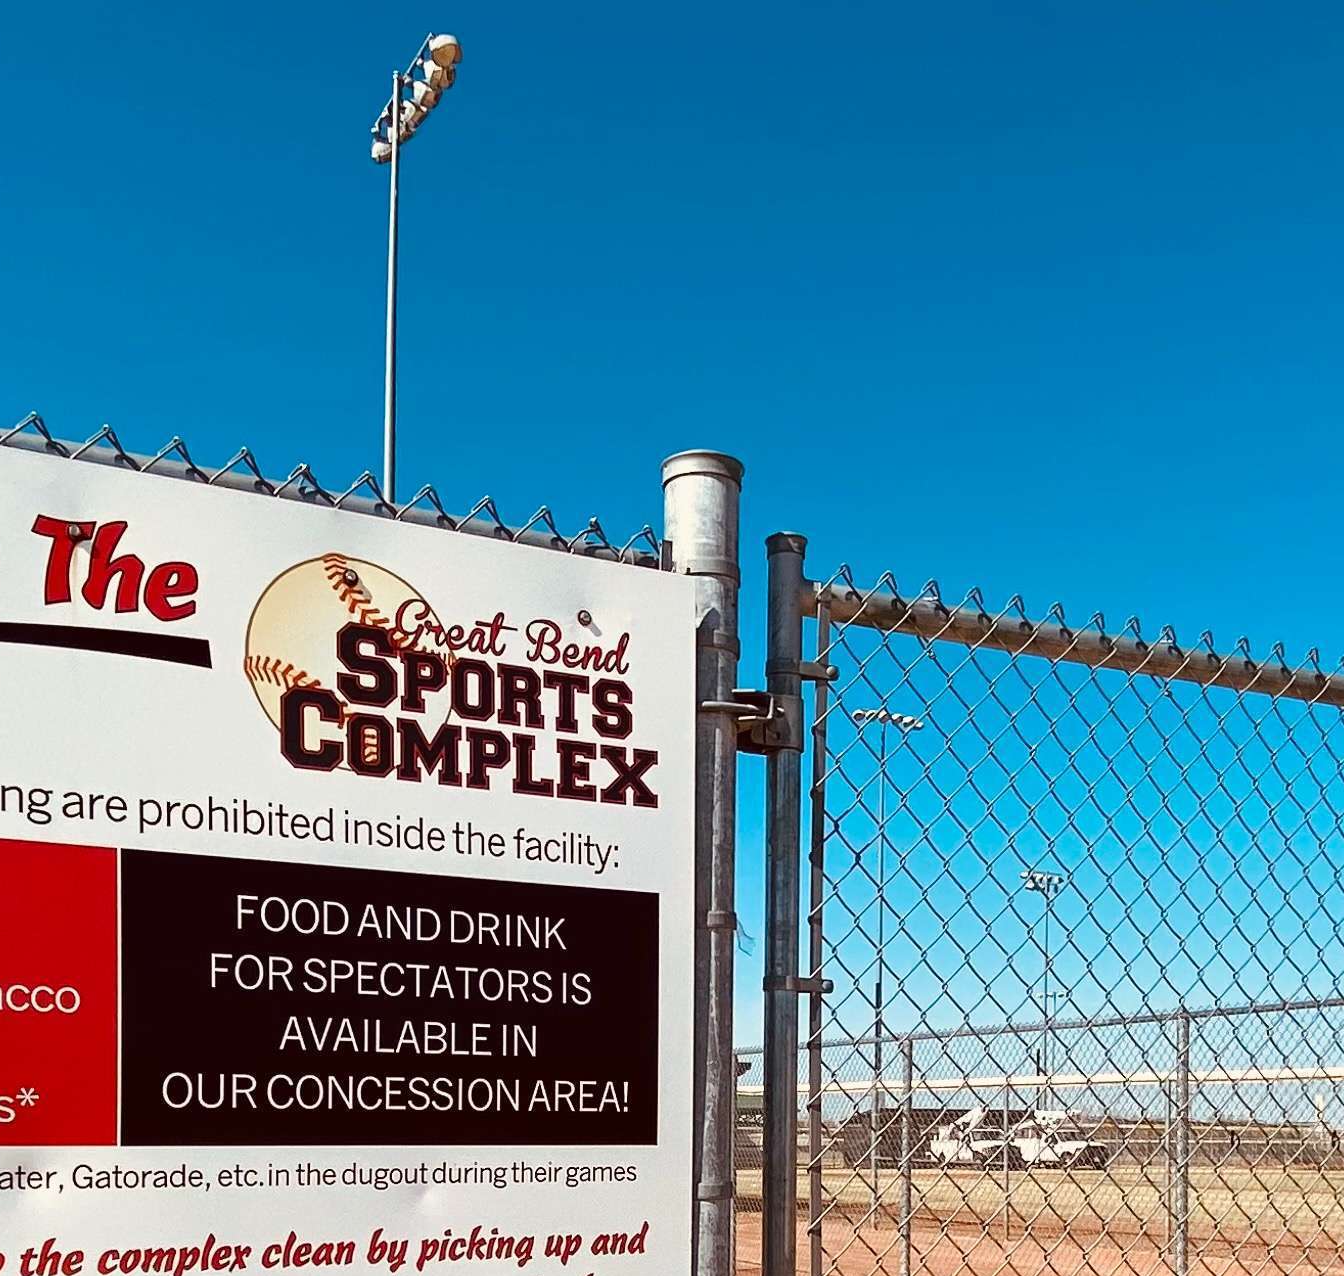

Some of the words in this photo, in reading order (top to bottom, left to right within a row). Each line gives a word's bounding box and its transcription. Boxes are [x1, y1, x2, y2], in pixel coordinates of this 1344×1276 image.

[30, 513, 199, 623] The
[394, 598, 518, 656] Great
[525, 619, 630, 674] Bend
[336, 621, 633, 739] SPORTS
[280, 685, 659, 808] COMPLEX
[62, 791, 128, 823] are
[139, 795, 334, 842] prohibited
[344, 809, 446, 852] inside
[451, 821, 506, 858] the
[512, 827, 619, 875] facility:
[237, 894, 350, 936] FOOD
[356, 903, 441, 941] AND
[450, 910, 567, 950] DRINK
[211, 952, 294, 992] FOR
[302, 957, 553, 1004] SPECTATORS
[562, 972, 592, 1006] IS
[279, 1015, 492, 1056] AVAILABLE
[502, 1024, 537, 1057] IN
[162, 1071, 257, 1109] OUR
[266, 1074, 520, 1112] CONCESSION
[528, 1079, 629, 1113] AREA!
[72, 1163, 211, 1192] Gatorade,
[268, 1162, 290, 1187] in
[295, 1162, 337, 1186] the
[341, 1162, 429, 1191] dugout
[432, 1161, 508, 1189] during
[510, 1161, 563, 1184] their
[565, 1165, 637, 1188] games
[261, 1230, 356, 1269] clean
[366, 1227, 409, 1274] by
[415, 1224, 535, 1273] picking
[544, 1234, 583, 1267] up
[590, 1220, 650, 1256] and
